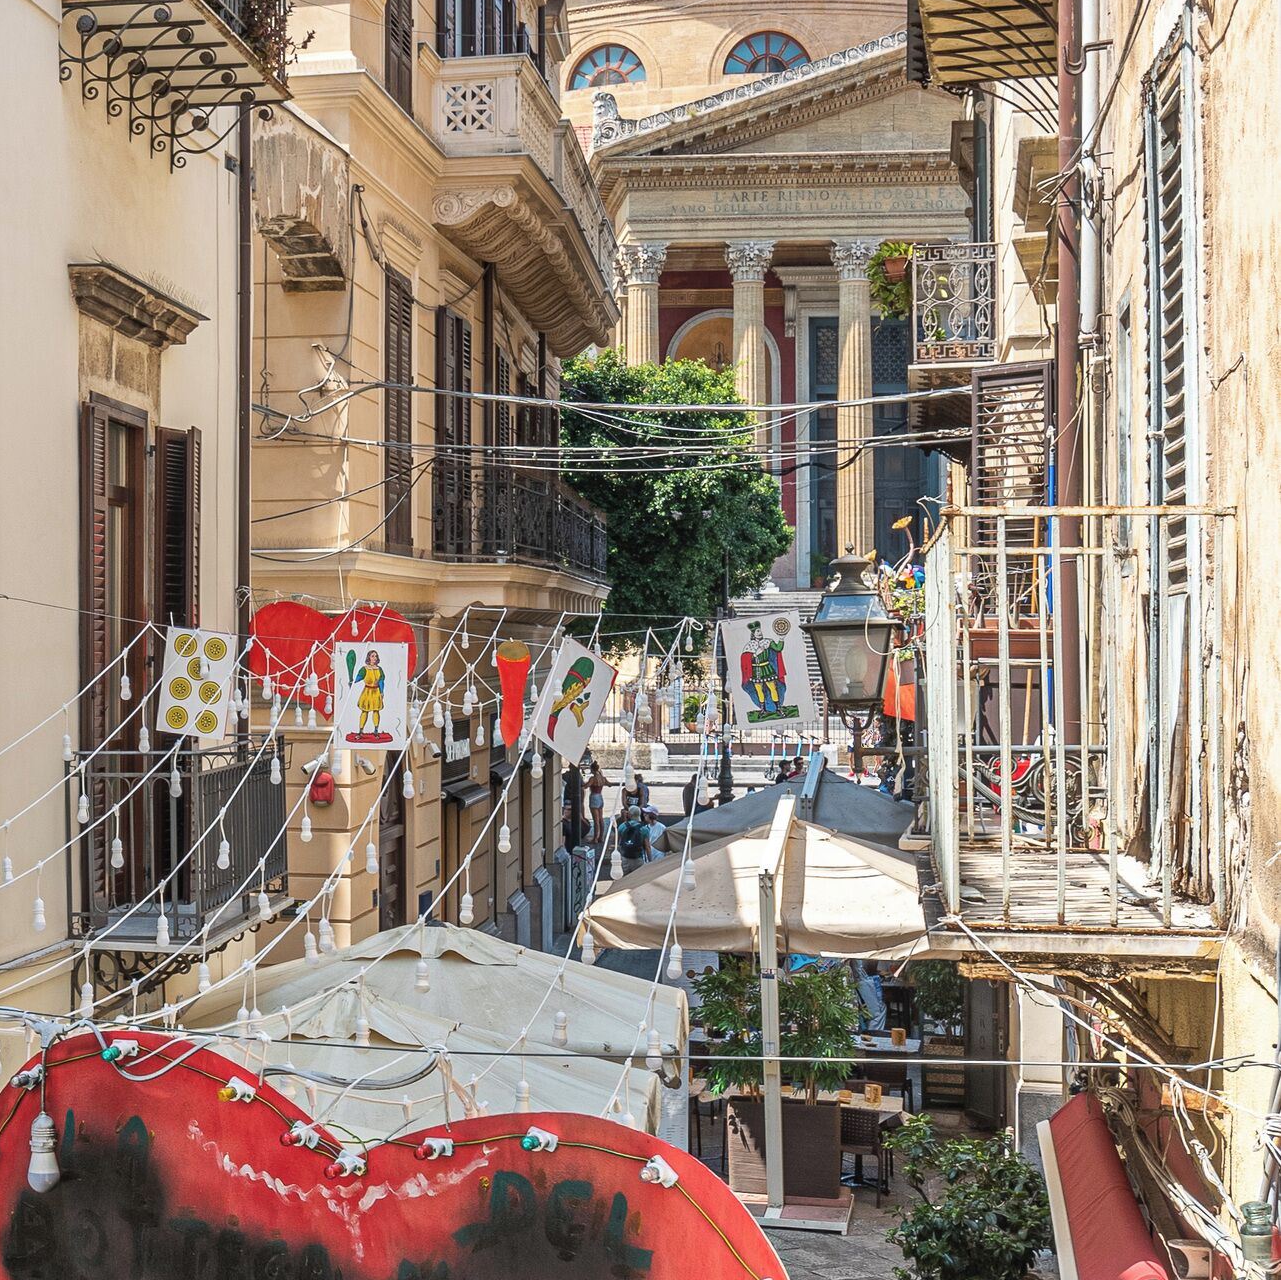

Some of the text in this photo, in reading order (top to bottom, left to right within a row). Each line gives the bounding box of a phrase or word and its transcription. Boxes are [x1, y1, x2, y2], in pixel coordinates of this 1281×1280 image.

[778, 189, 851, 202] RINNOVA
[671, 204, 706, 214] VANO
[925, 199, 954, 210] NON
